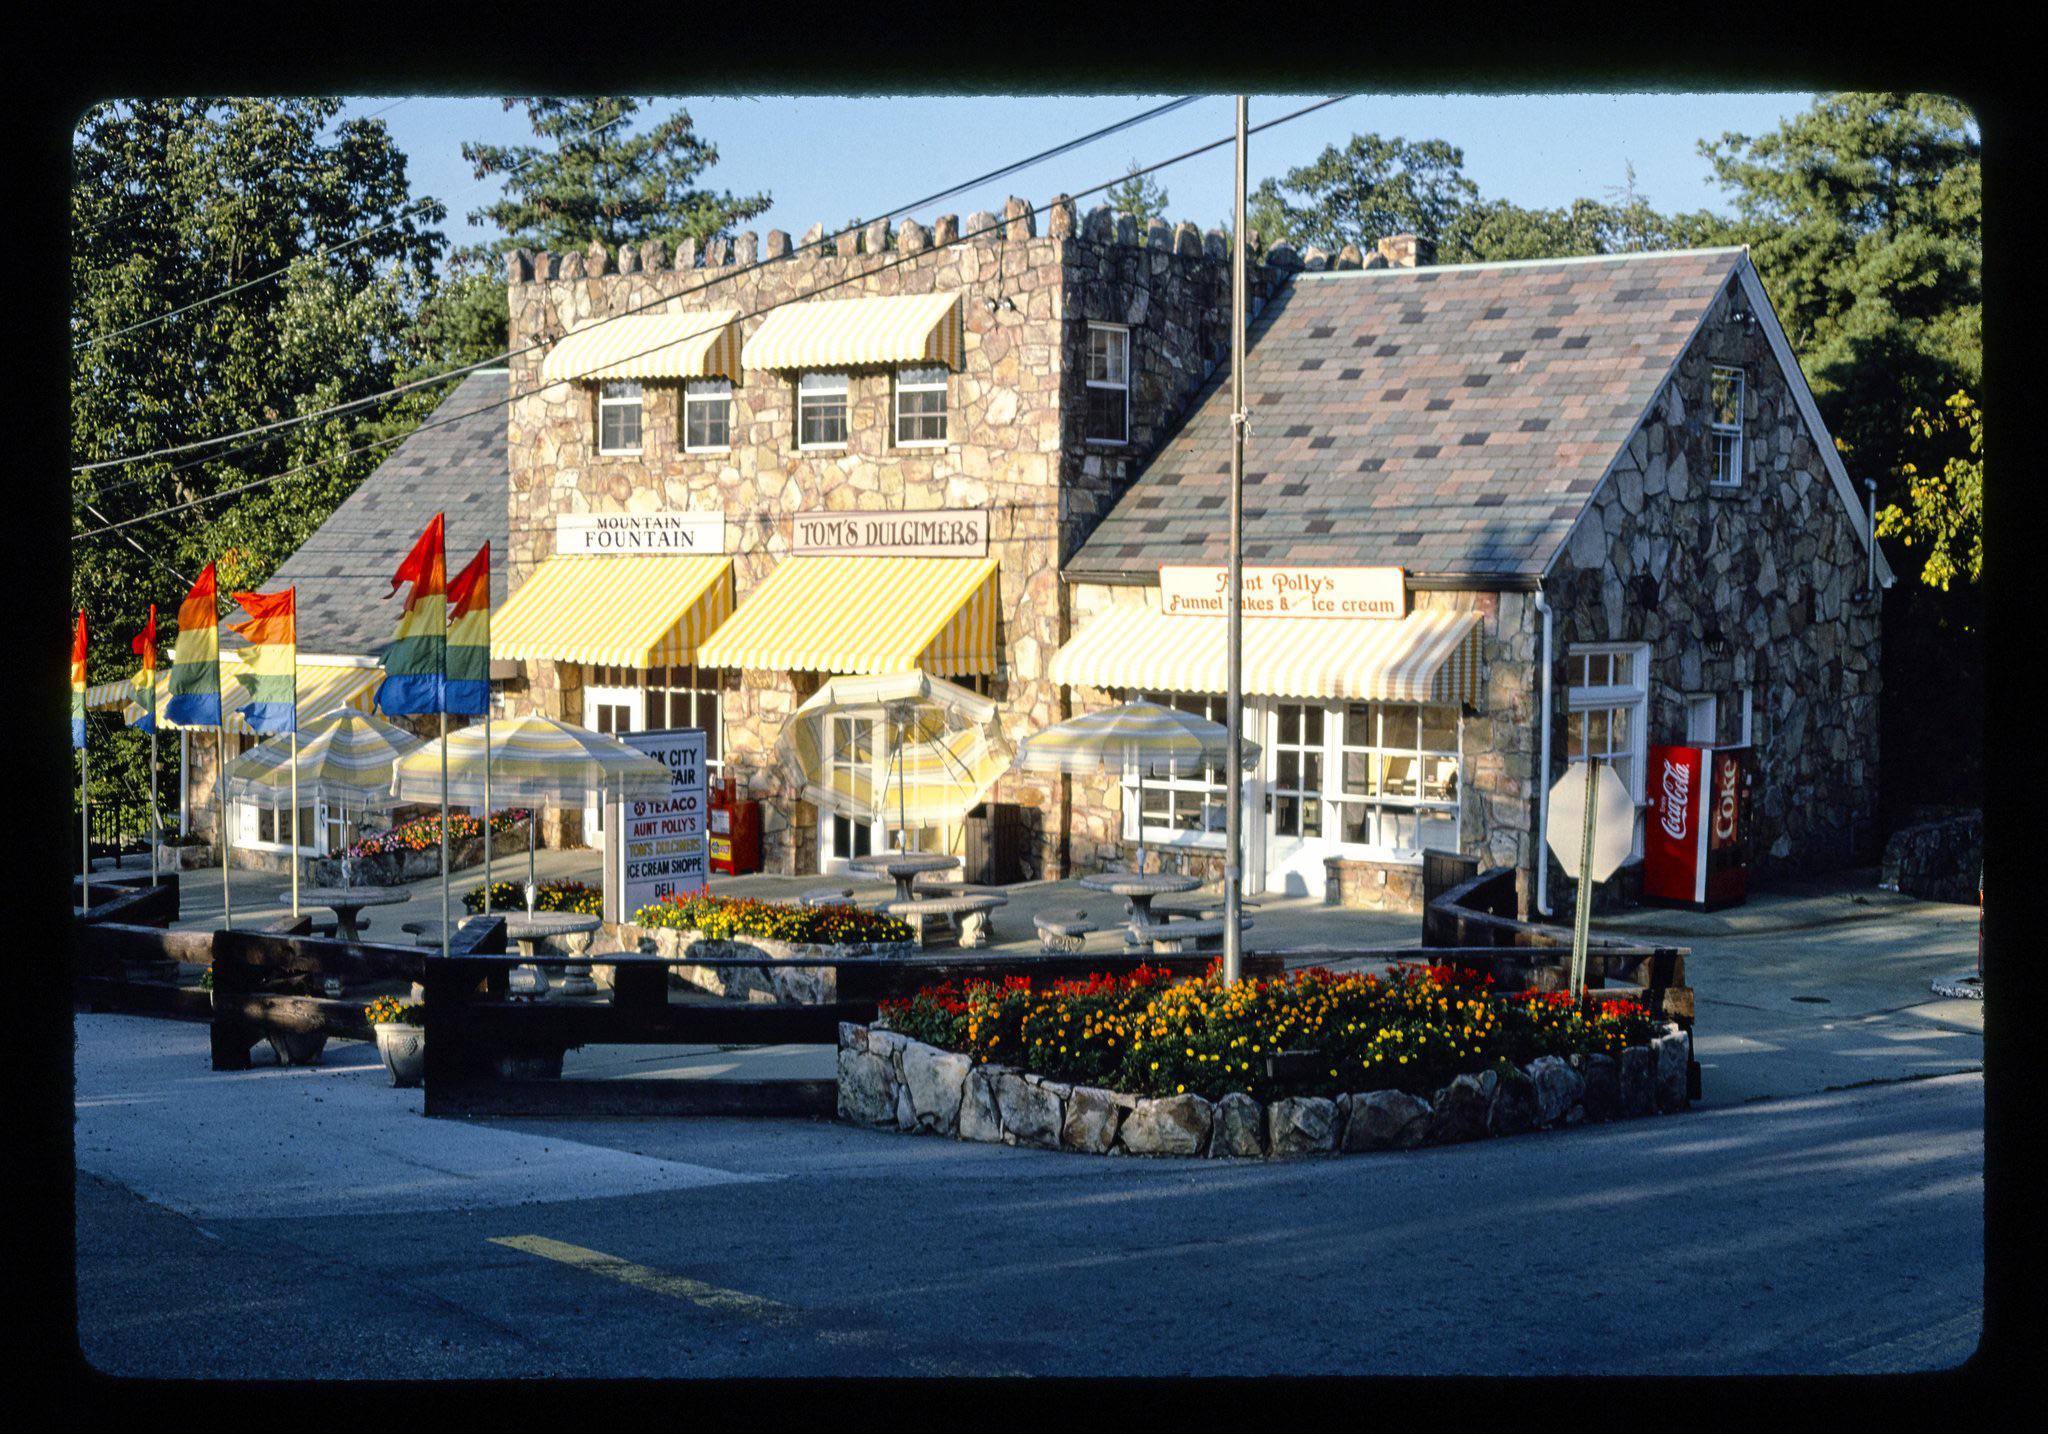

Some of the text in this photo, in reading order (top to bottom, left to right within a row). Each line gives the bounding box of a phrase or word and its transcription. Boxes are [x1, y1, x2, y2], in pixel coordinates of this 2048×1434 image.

[597, 517, 680, 529] MOUNTAIN
[800, 519, 858, 546] TOM'S
[585, 531, 694, 548] FOUNTAIN
[1216, 573, 1334, 594] Ant Polly's
[1170, 594, 1222, 611] Funnel
[1280, 597, 1289, 611] &
[1312, 594, 1334, 611] ice
[1342, 600, 1395, 612] cream
[669, 749, 697, 766] CITY
[649, 797, 697, 814] TEXACO
[1716, 760, 1737, 839] Coke
[634, 822, 657, 837] AUNT
[661, 817, 696, 834] POLLY'S
[627, 857, 702, 879] ICE CREAM SHOPPE
